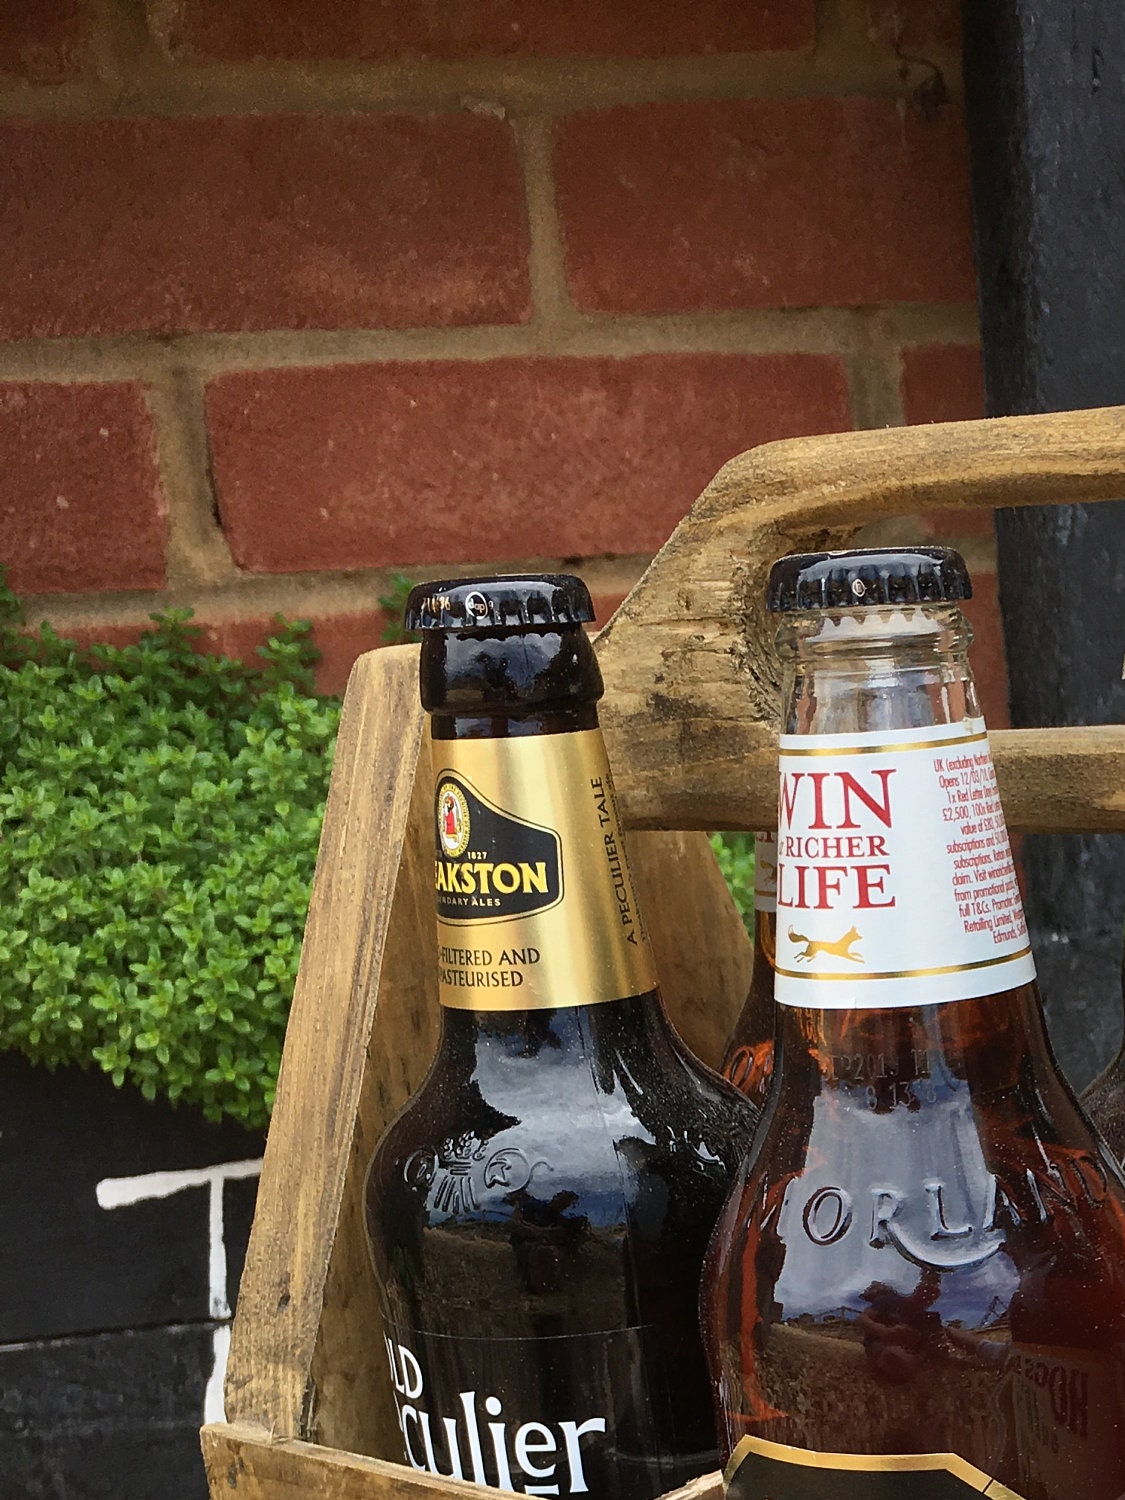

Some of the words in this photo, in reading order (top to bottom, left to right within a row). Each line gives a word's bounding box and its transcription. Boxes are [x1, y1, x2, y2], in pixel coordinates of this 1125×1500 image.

[939, 775, 960, 791] Opens
[590, 776, 611, 829] TALE
[778, 769, 897, 831] WIN
[467, 851, 487, 859] 1827
[786, 835, 890, 858] RICHER
[604, 831, 633, 926] PECULIER
[778, 864, 896, 909] LIFE
[471, 897, 501, 907] ALES
[954, 889, 971, 902] from
[626, 929, 638, 946] A
[498, 947, 541, 967] AND
[383, 1330, 423, 1399] LD
[394, 1391, 606, 1494] culier
